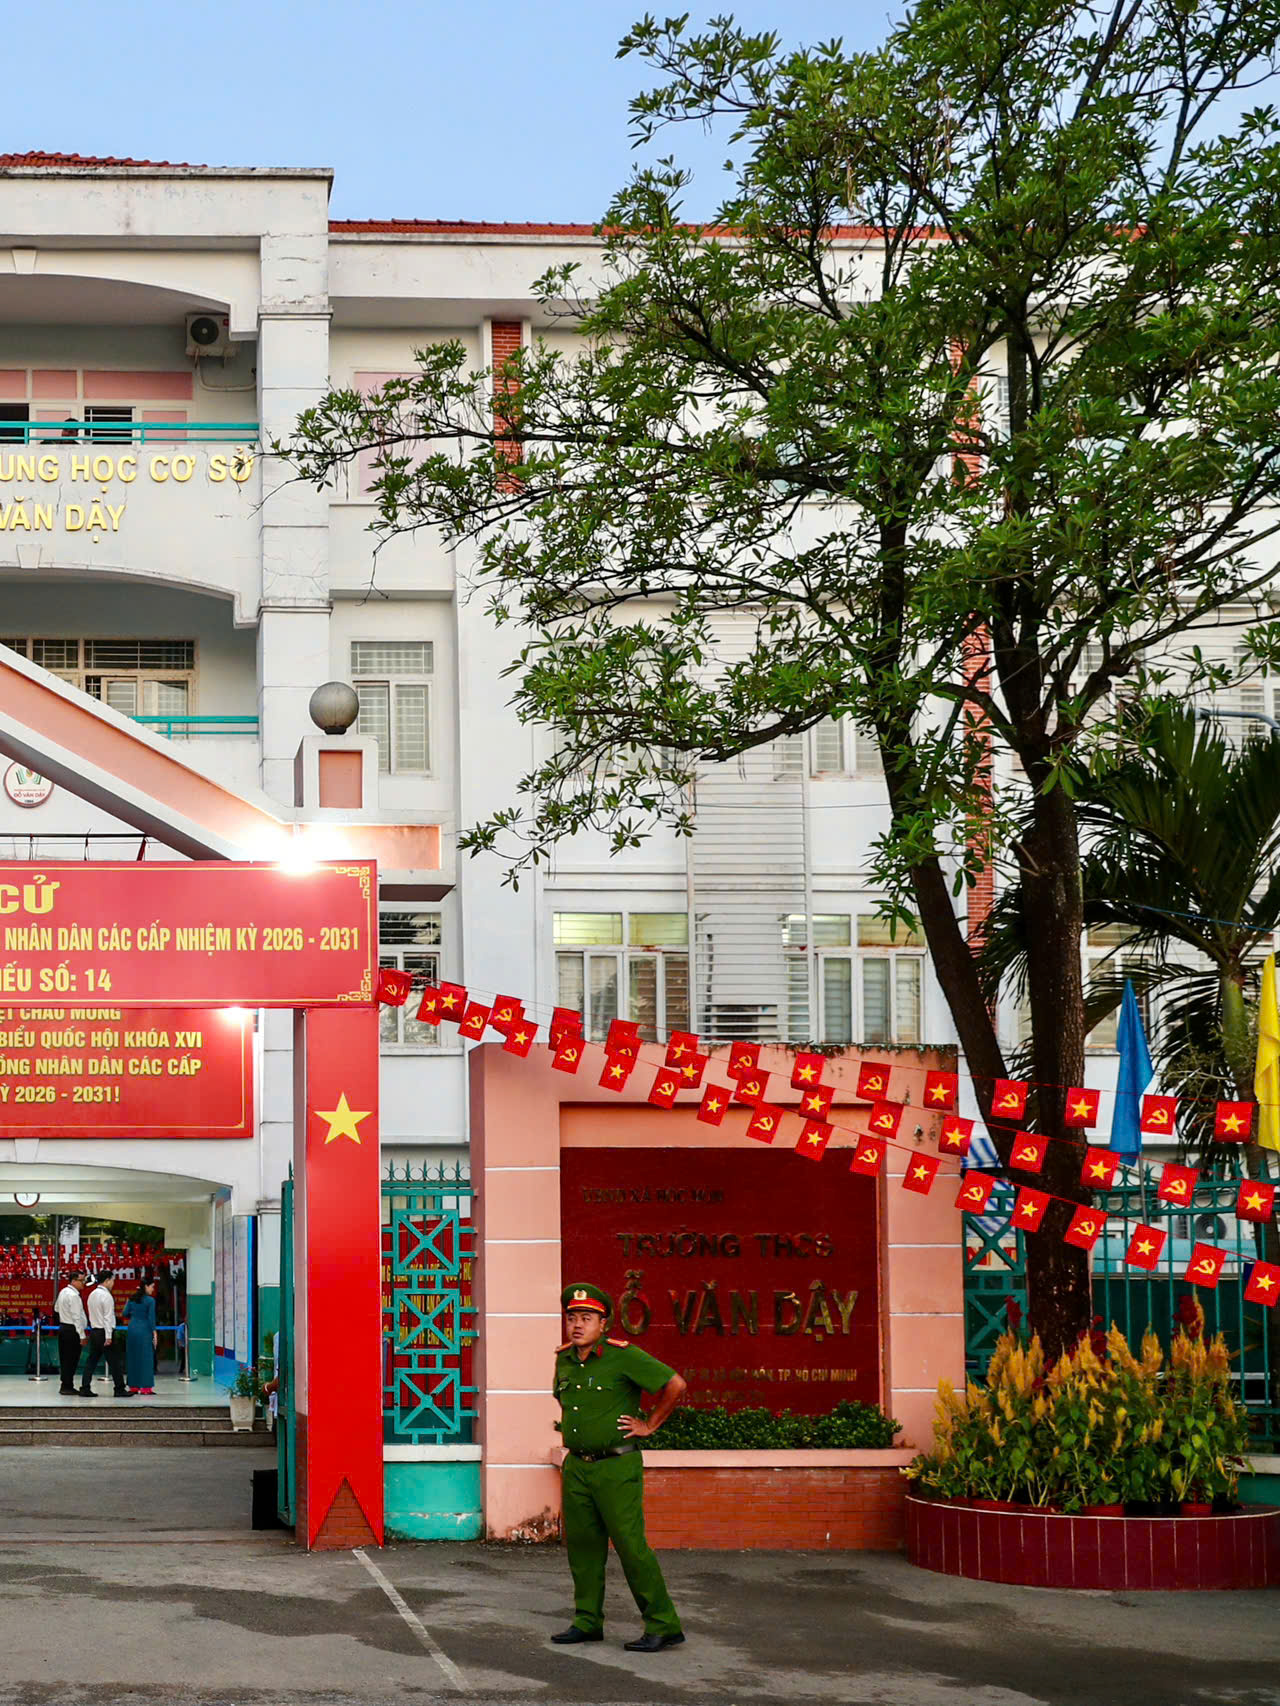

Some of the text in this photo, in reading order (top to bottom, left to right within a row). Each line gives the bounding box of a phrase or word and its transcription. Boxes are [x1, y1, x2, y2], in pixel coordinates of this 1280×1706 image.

[71, 454, 137, 495] HỌC
[150, 454, 198, 483] CƠ
[209, 446, 254, 483] SỞ
[65, 496, 126, 545] DẬY
[5, 923, 53, 951] NHÂN
[58, 923, 93, 951] DÂN
[97, 922, 132, 952] CÁC
[136, 920, 170, 952] CẤP
[175, 923, 232, 956] NHIỆM
[236, 922, 258, 951] KỲ
[262, 927, 304, 952] 2026
[320, 927, 359, 952] 2031
[40, 962, 78, 993] SỐ:
[84, 968, 113, 992] 14
[40, 1026, 86, 1050] QUỐC
[90, 1028, 119, 1051] HỘI
[124, 1027, 170, 1048] KHÓA
[174, 1031, 203, 1049] XVI
[35, 1055, 83, 1075] NHÂN
[87, 1055, 124, 1075] DÂN
[128, 1055, 163, 1075] CÁC
[167, 1053, 202, 1076] CẤP
[14, 1085, 56, 1103] 2026
[72, 1085, 120, 1103] 2031!
[616, 1225, 833, 1258] TRƯỜNG THCS
[668, 1279, 760, 1335] VĂN
[774, 1279, 859, 1342] DẬY
